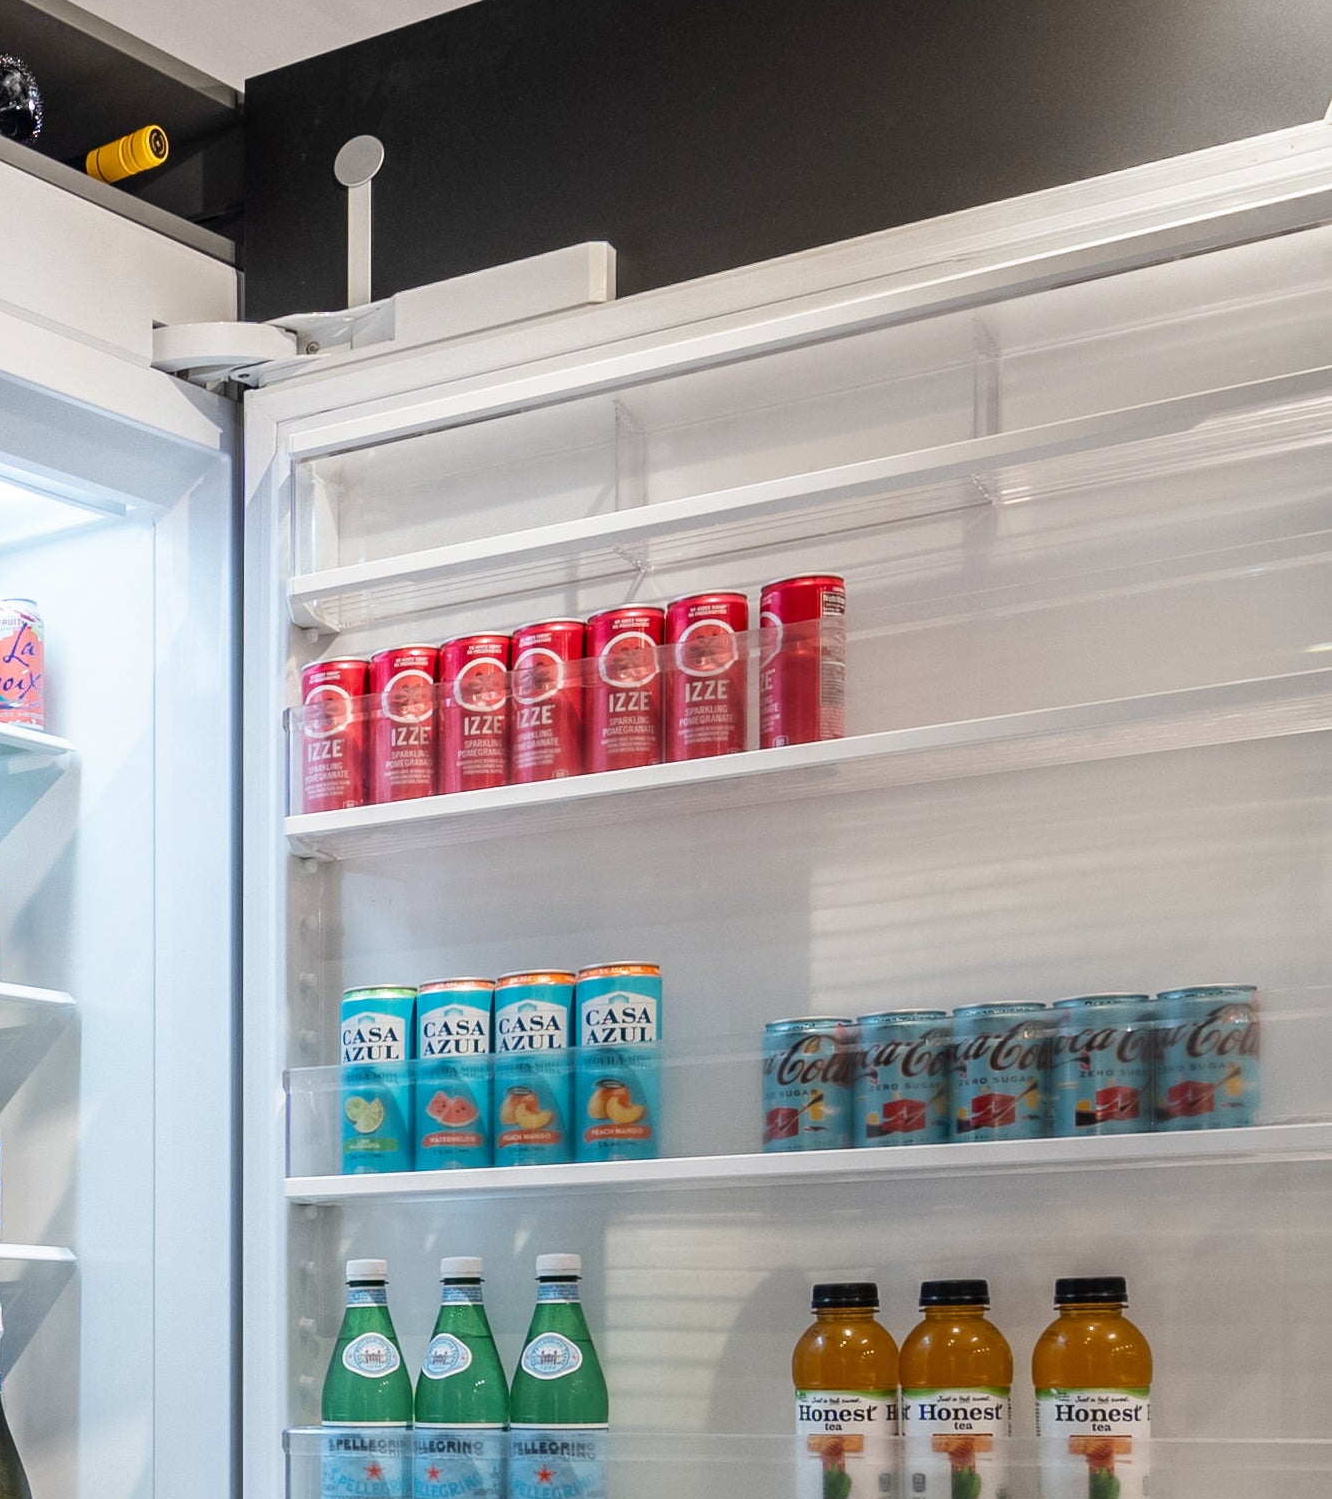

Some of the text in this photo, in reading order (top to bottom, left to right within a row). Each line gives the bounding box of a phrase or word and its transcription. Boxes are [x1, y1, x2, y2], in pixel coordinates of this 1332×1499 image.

[3, 622, 35, 667] La
[685, 680, 728, 703] IZZE
[608, 691, 650, 713] IZZE
[685, 704, 728, 717] SPARKLING
[464, 715, 503, 736] IZZE
[516, 705, 554, 730] IZZE
[608, 715, 650, 726] SPARKLING
[390, 727, 430, 747] IZZE
[307, 739, 343, 763] IZZE
[498, 1014, 561, 1035] CASA
[585, 1007, 652, 1027] CASA
[343, 1027, 399, 1046] CASA
[423, 1019, 485, 1038] CASA
[586, 1026, 653, 1045] AZUL
[423, 1038, 485, 1056] AZUL
[498, 1034, 562, 1054] AZUL
[343, 1045, 399, 1063] AZUL
[1079, 1068, 1114, 1078] ZERO
[429, 1135, 476, 1144] WATERMELON
[523, 1132, 552, 1140] MANGO
[591, 1127, 643, 1136] PEACH MANGO
[799, 1404, 877, 1422] Honest
[919, 1403, 1002, 1421] Honest
[1055, 1404, 1142, 1422] Honest
[824, 1422, 843, 1431] tea
[954, 1422, 973, 1431] tea
[1092, 1422, 1112, 1432] tea
